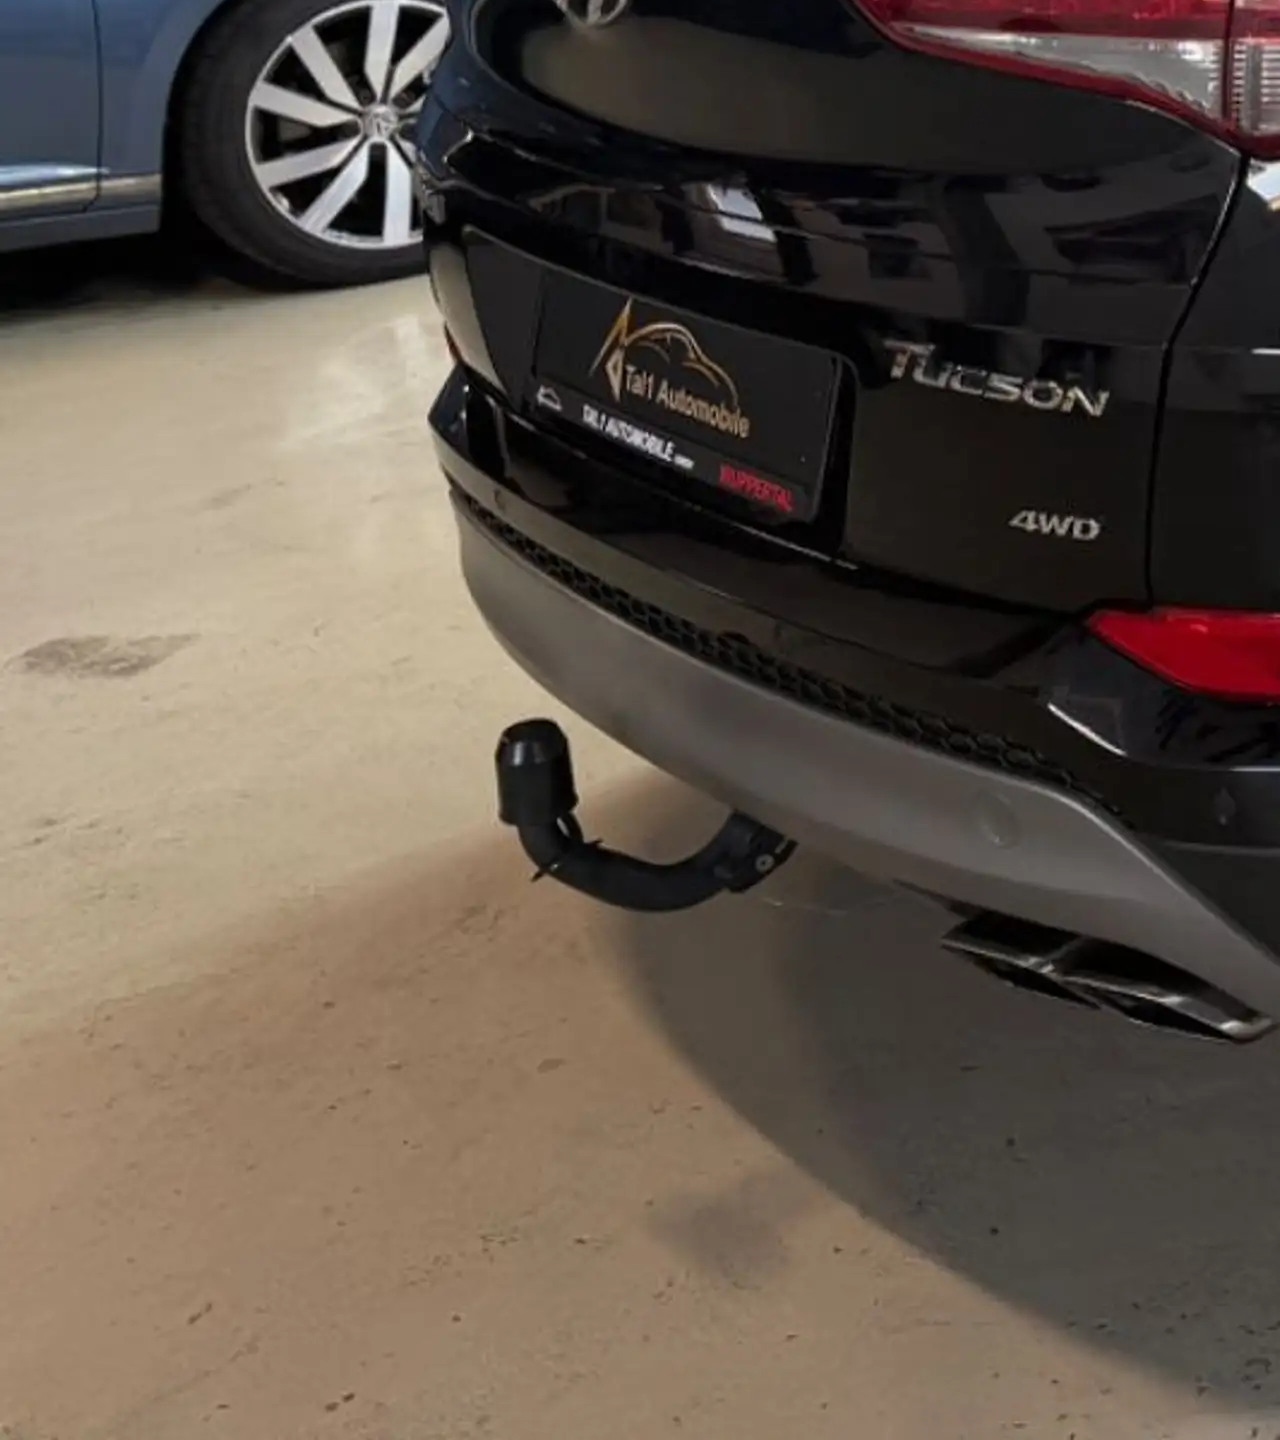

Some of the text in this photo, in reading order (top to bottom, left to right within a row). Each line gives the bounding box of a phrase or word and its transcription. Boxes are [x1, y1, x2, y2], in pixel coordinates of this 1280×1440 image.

[883, 339, 1110, 417] TUCSON
[655, 379, 749, 440] Automobile
[1008, 510, 1101, 541] 4WD
